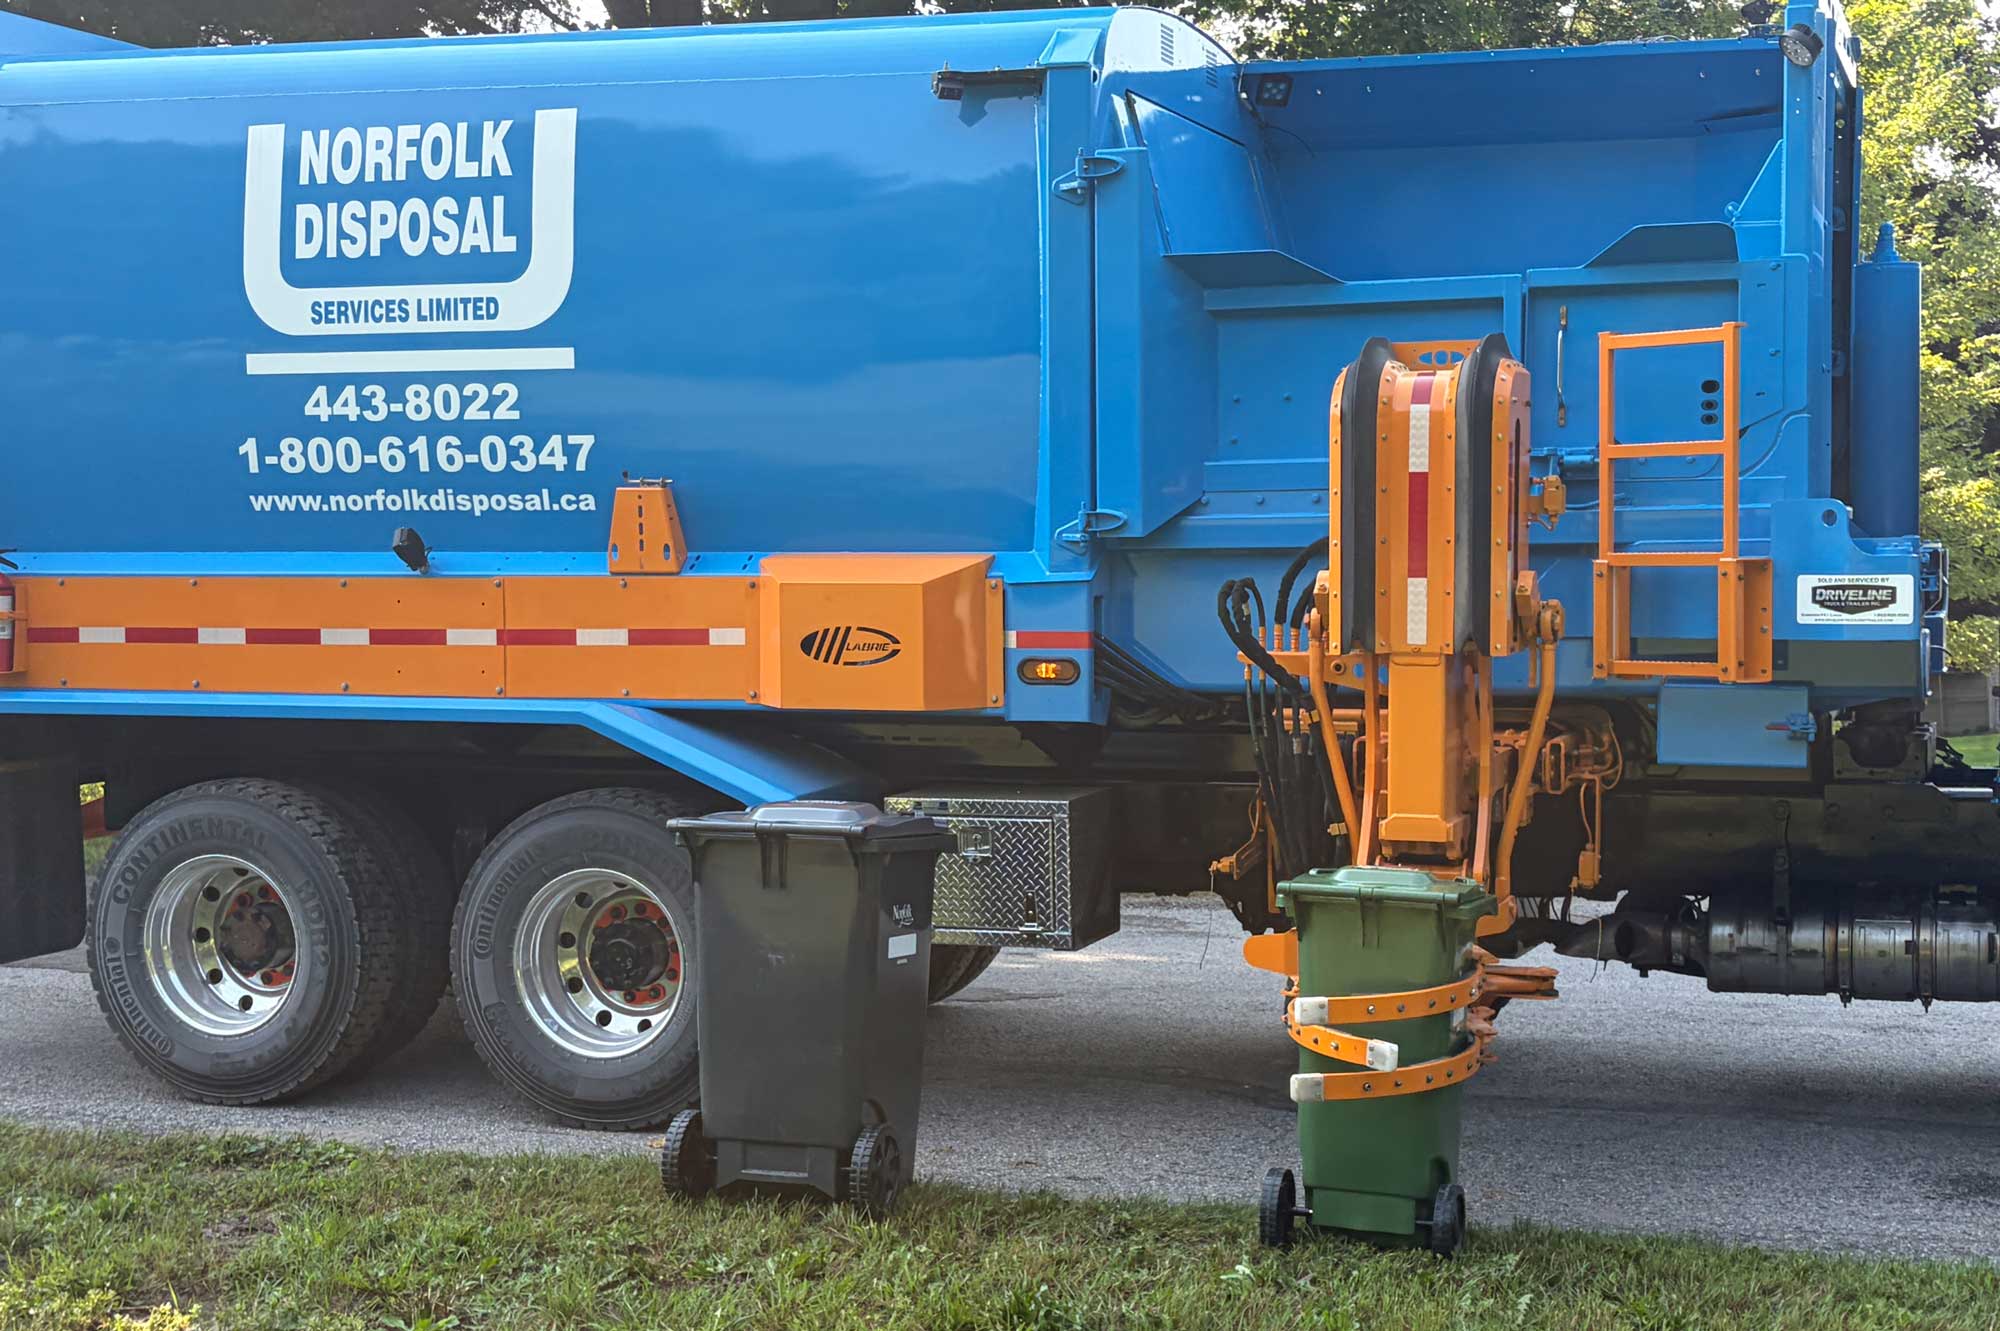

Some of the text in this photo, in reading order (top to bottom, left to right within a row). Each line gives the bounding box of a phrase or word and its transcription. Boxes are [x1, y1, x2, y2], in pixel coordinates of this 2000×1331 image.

[299, 119, 514, 185] NORFOLK
[295, 195, 517, 259] DISPOSAL
[310, 296, 500, 325] SERVICES LIMITED
[304, 382, 520, 422] 443-8022
[238, 434, 596, 474] 1-800-616-0347
[249, 488, 597, 516] www.norfolkdisposal.ca
[1815, 588, 1893, 601] DRIVELINE
[845, 642, 890, 652] LABRIE
[113, 815, 266, 905] CONTINENTAL
